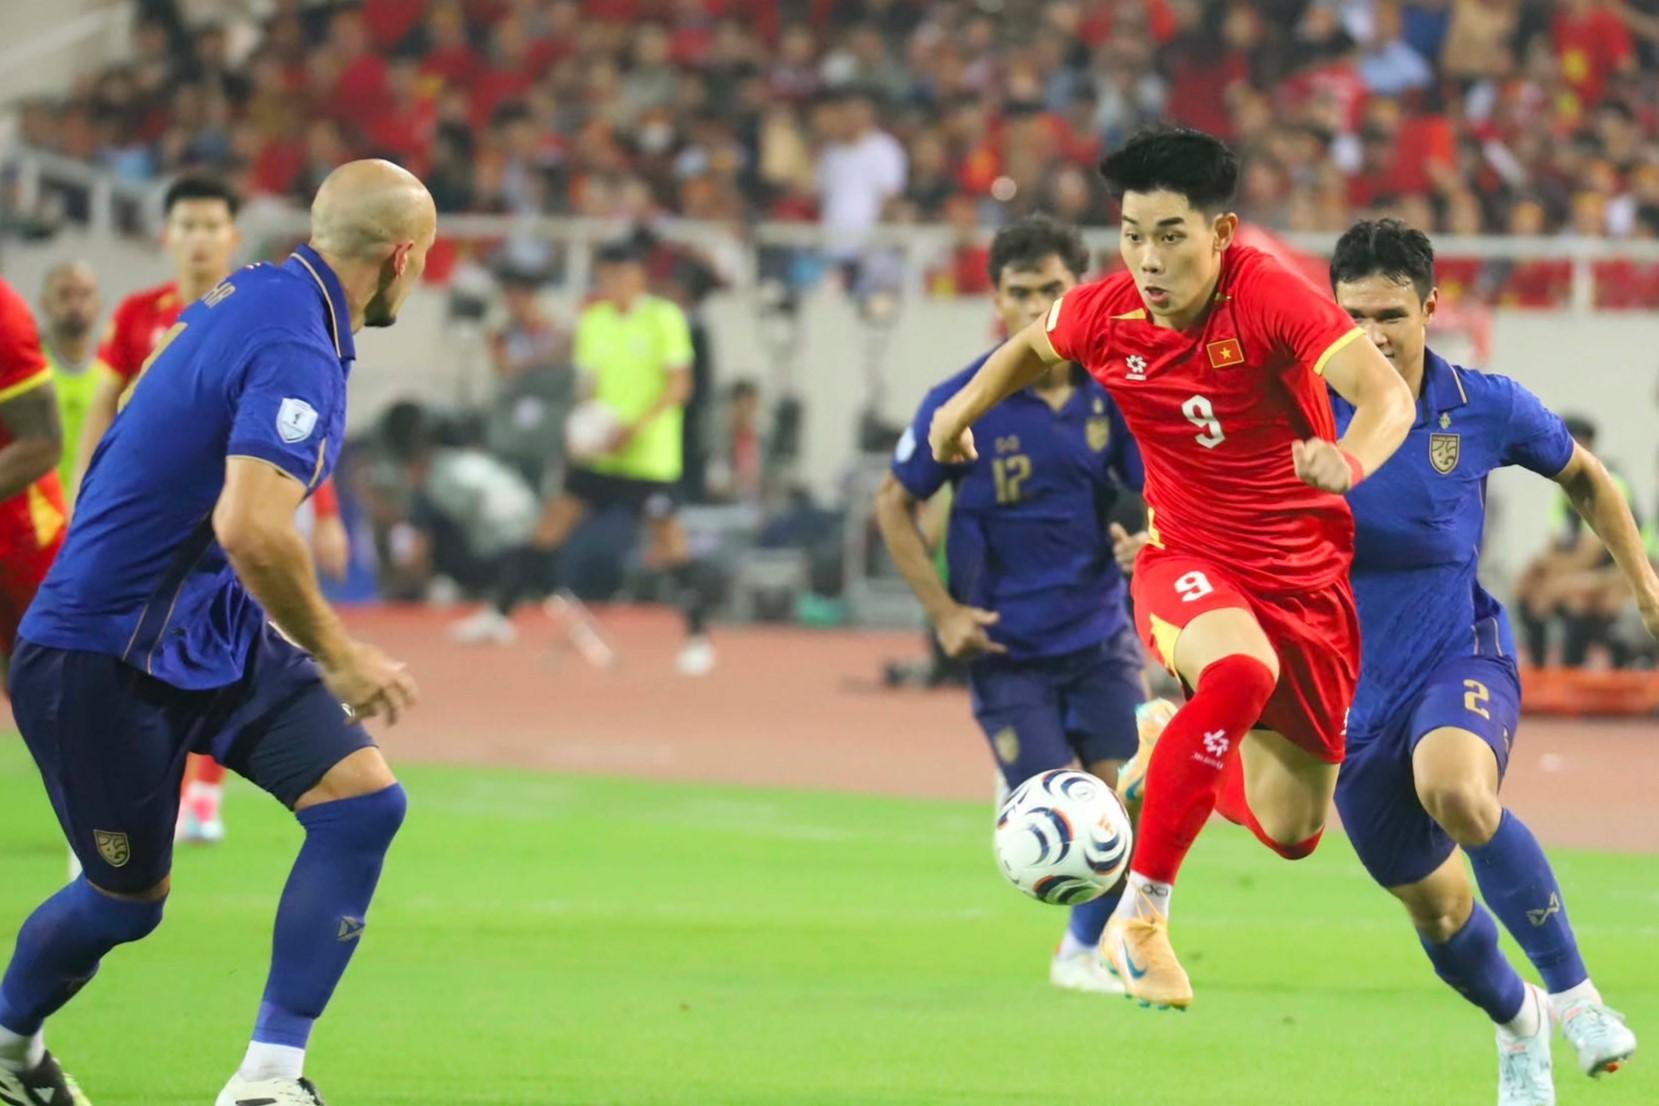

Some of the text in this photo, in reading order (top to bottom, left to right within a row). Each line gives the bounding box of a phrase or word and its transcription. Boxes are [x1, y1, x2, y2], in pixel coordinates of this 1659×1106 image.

[1181, 394, 1226, 449] 9
[992, 454, 1032, 505] 12
[1174, 570, 1215, 603] 9
[1463, 679, 1490, 721] 2
